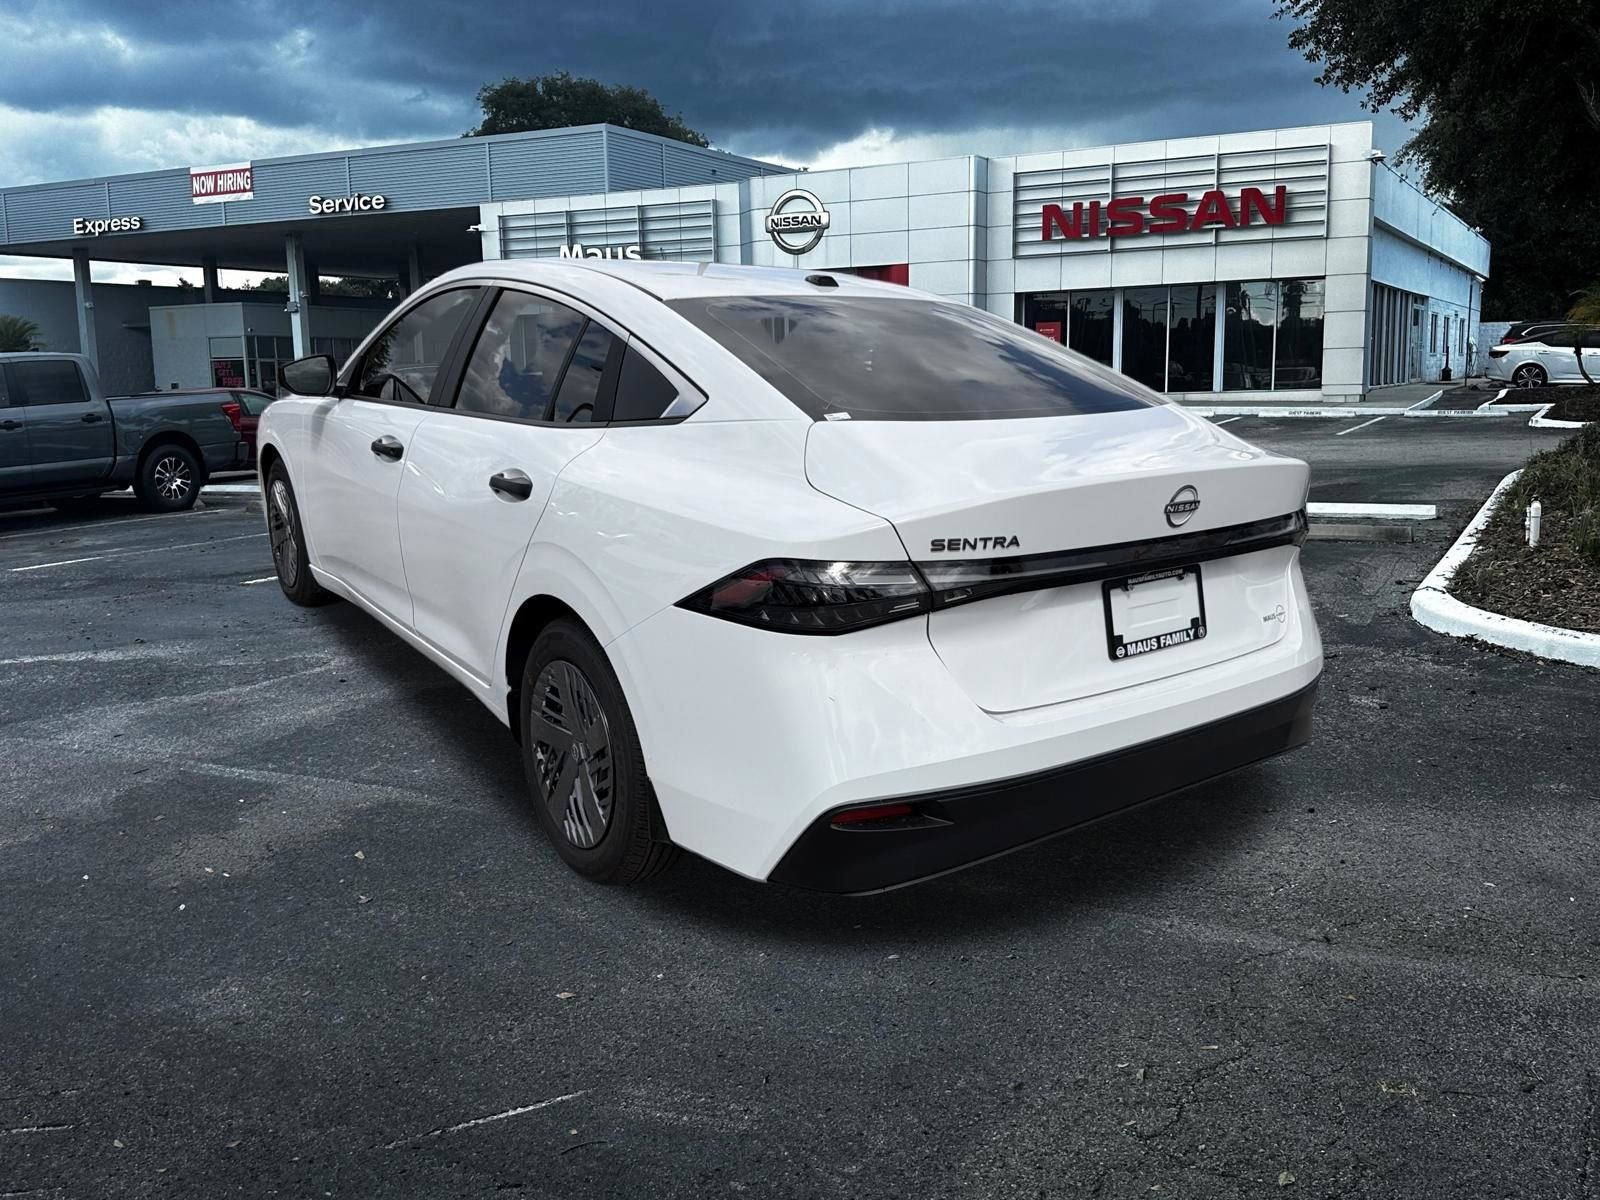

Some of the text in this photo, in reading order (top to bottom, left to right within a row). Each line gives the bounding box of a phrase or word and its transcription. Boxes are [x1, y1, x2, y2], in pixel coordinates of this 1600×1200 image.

[192, 170, 251, 195] NOW HIRING
[308, 192, 386, 215] Service
[1042, 185, 1287, 241] NISSAN
[73, 216, 141, 237] Express
[770, 215, 822, 229] NISSAN
[559, 243, 642, 261] Maus
[930, 534, 1020, 553] SENTRA
[1126, 628, 1195, 656] MAUS FAMILY
